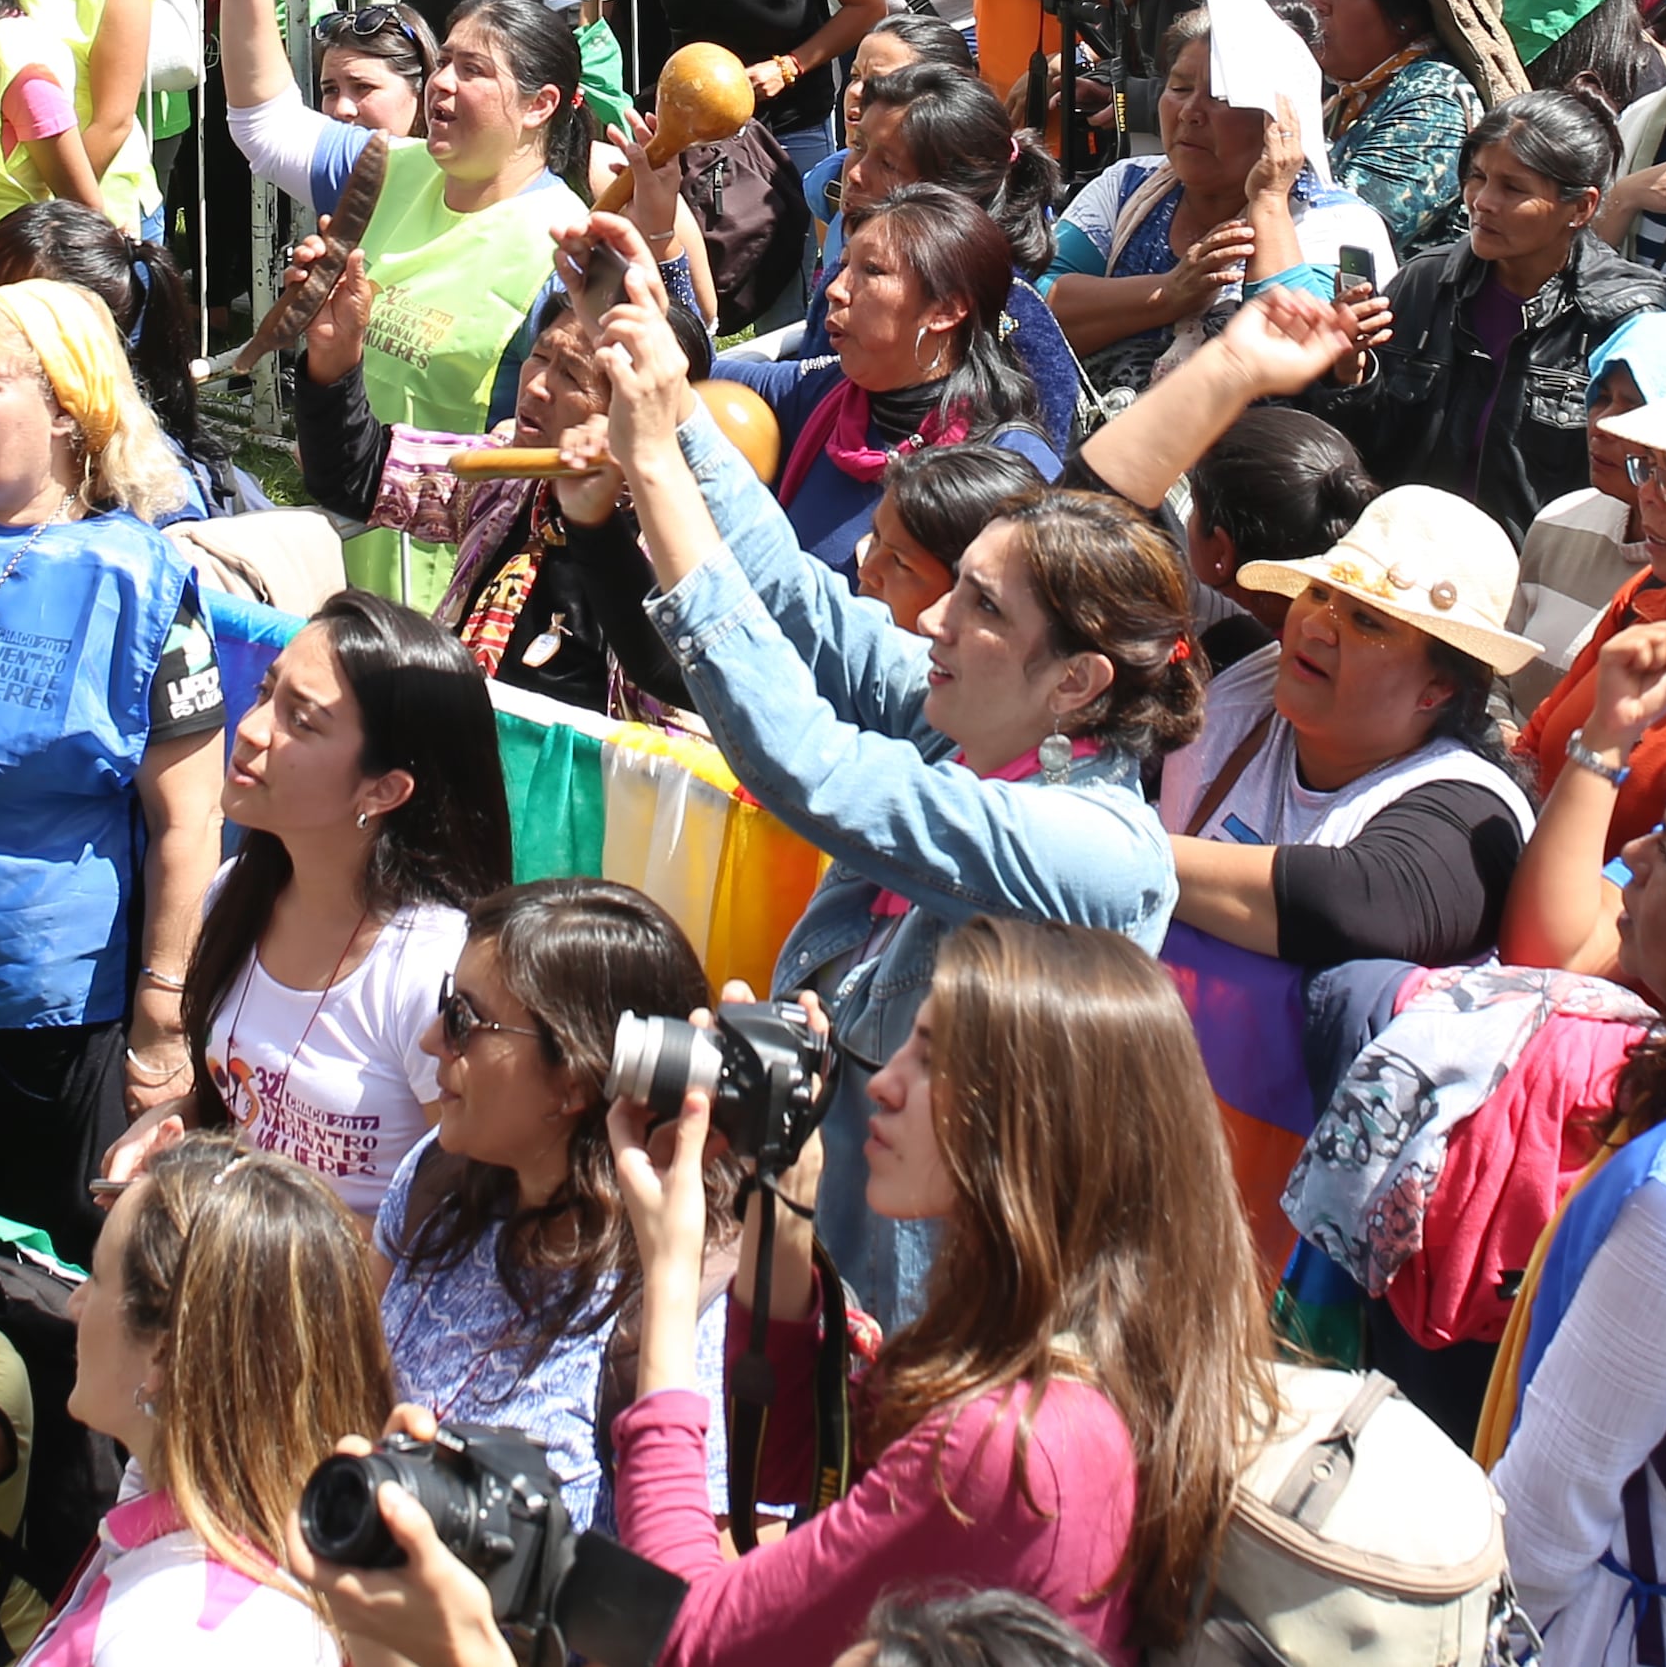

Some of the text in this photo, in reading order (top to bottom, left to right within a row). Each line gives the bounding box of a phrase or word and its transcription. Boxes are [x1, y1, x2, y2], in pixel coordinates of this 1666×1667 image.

[36, 636, 73, 654] 2017
[34, 673, 60, 692] DE
[333, 1114, 379, 1132] 2017
